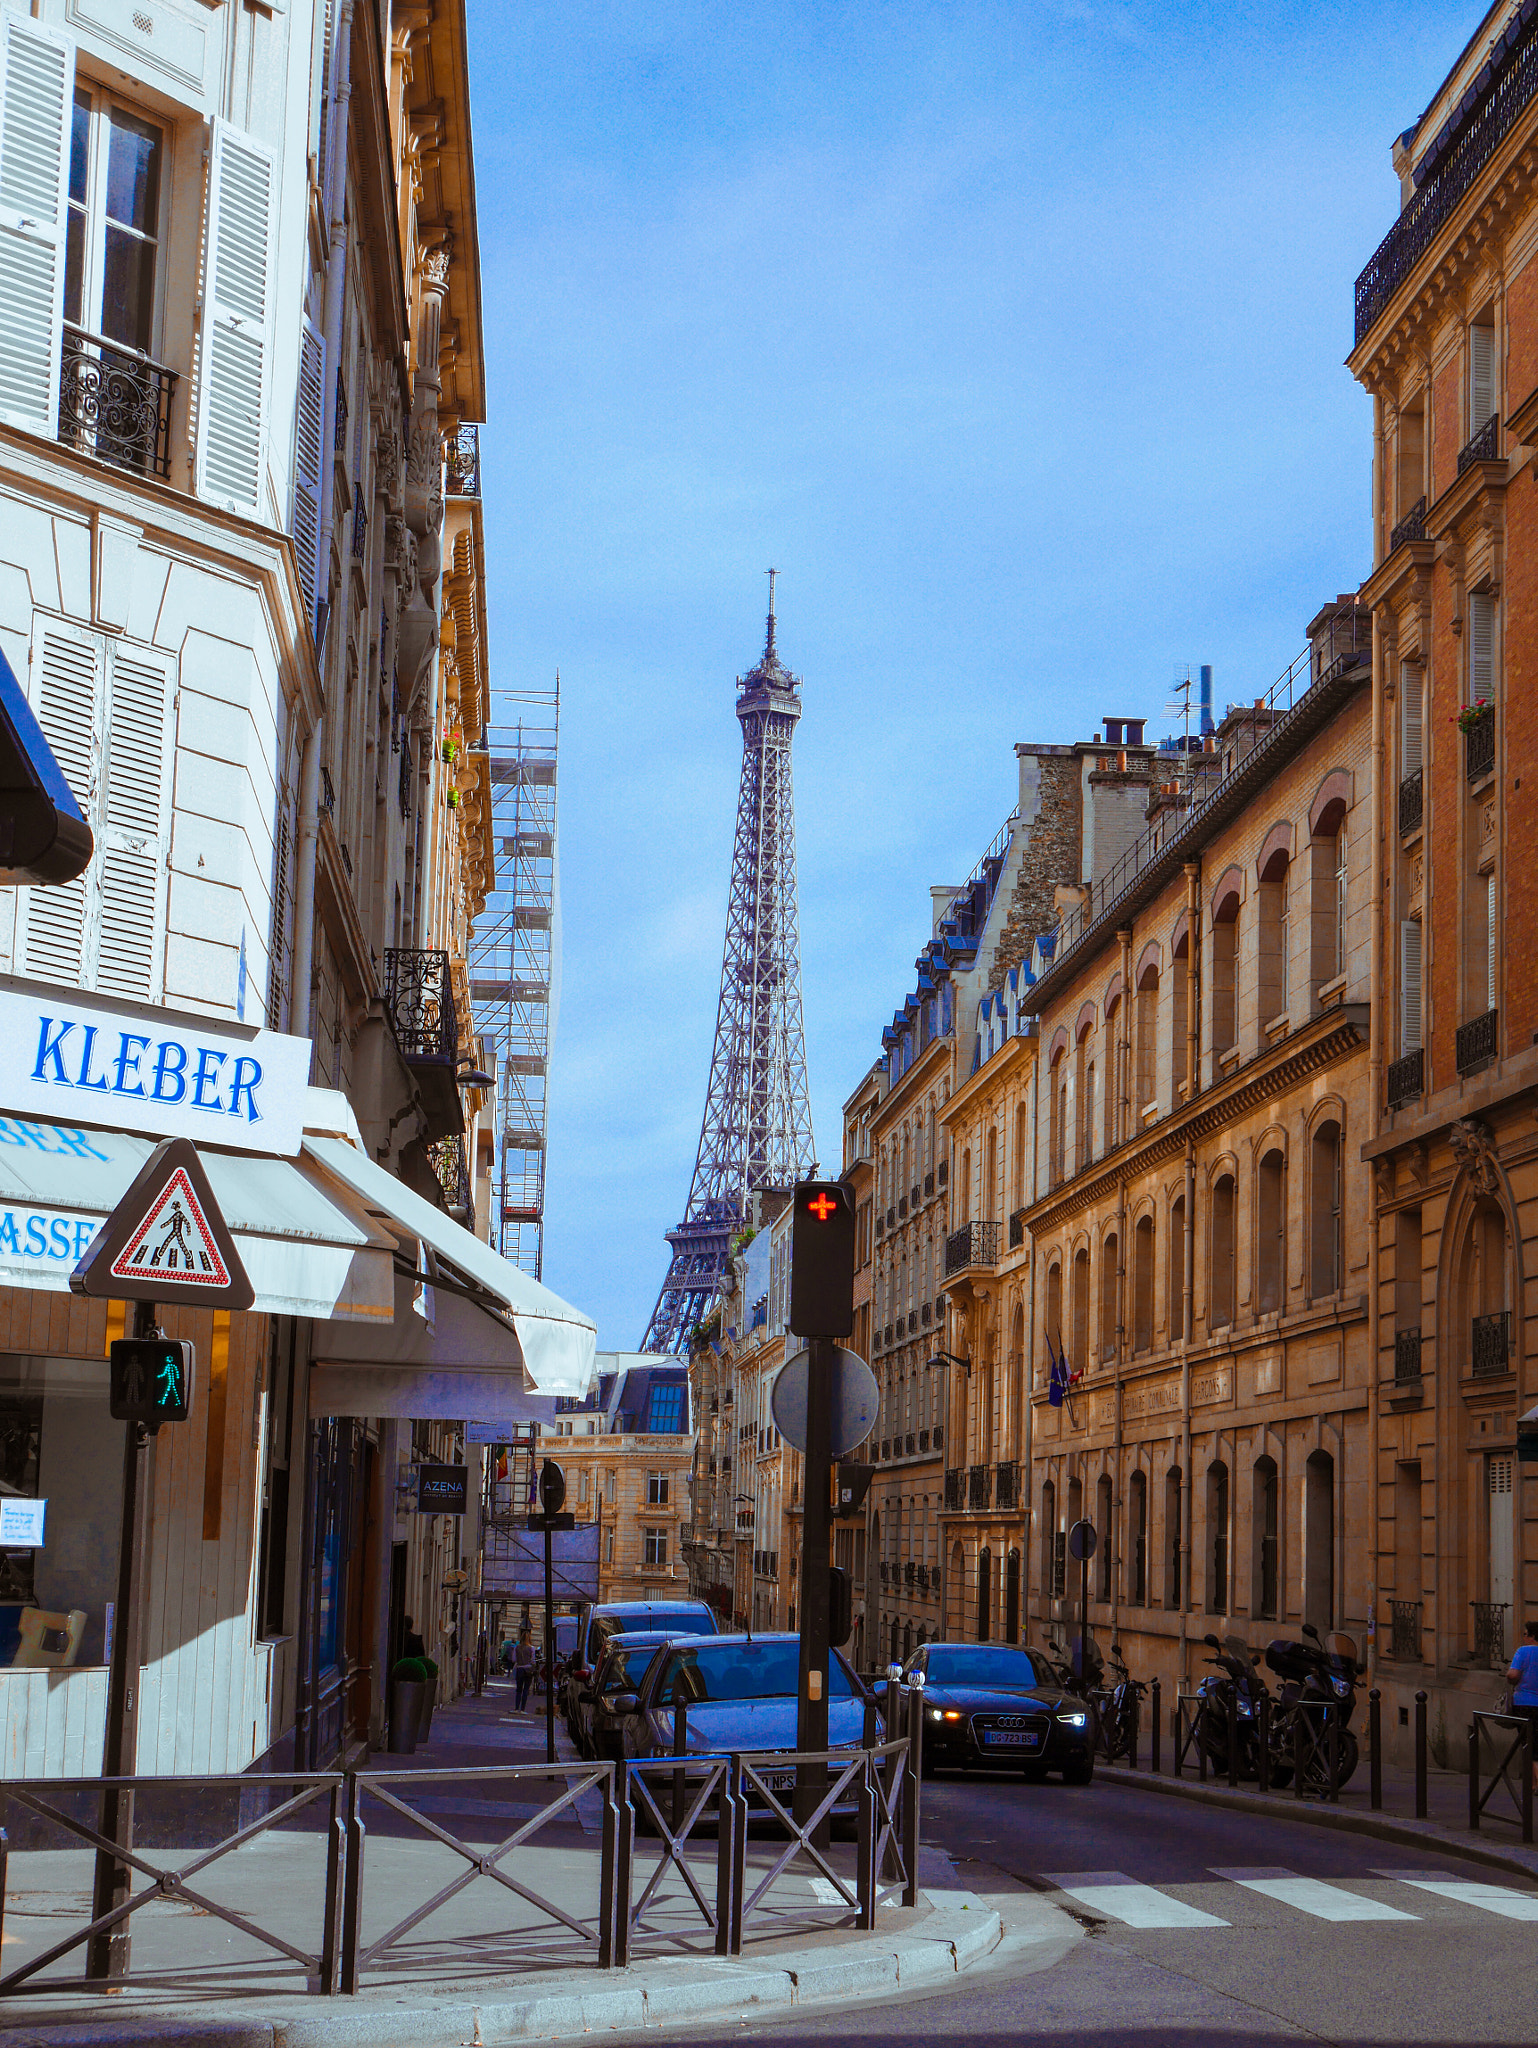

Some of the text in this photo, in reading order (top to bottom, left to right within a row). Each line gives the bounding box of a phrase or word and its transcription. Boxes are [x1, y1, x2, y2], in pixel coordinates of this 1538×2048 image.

[30, 1016, 264, 1125] KLEBER
[0, 1212, 101, 1262] ASSE
[424, 1481, 463, 1492] AZENA
[772, 1775, 794, 1789] NPS
